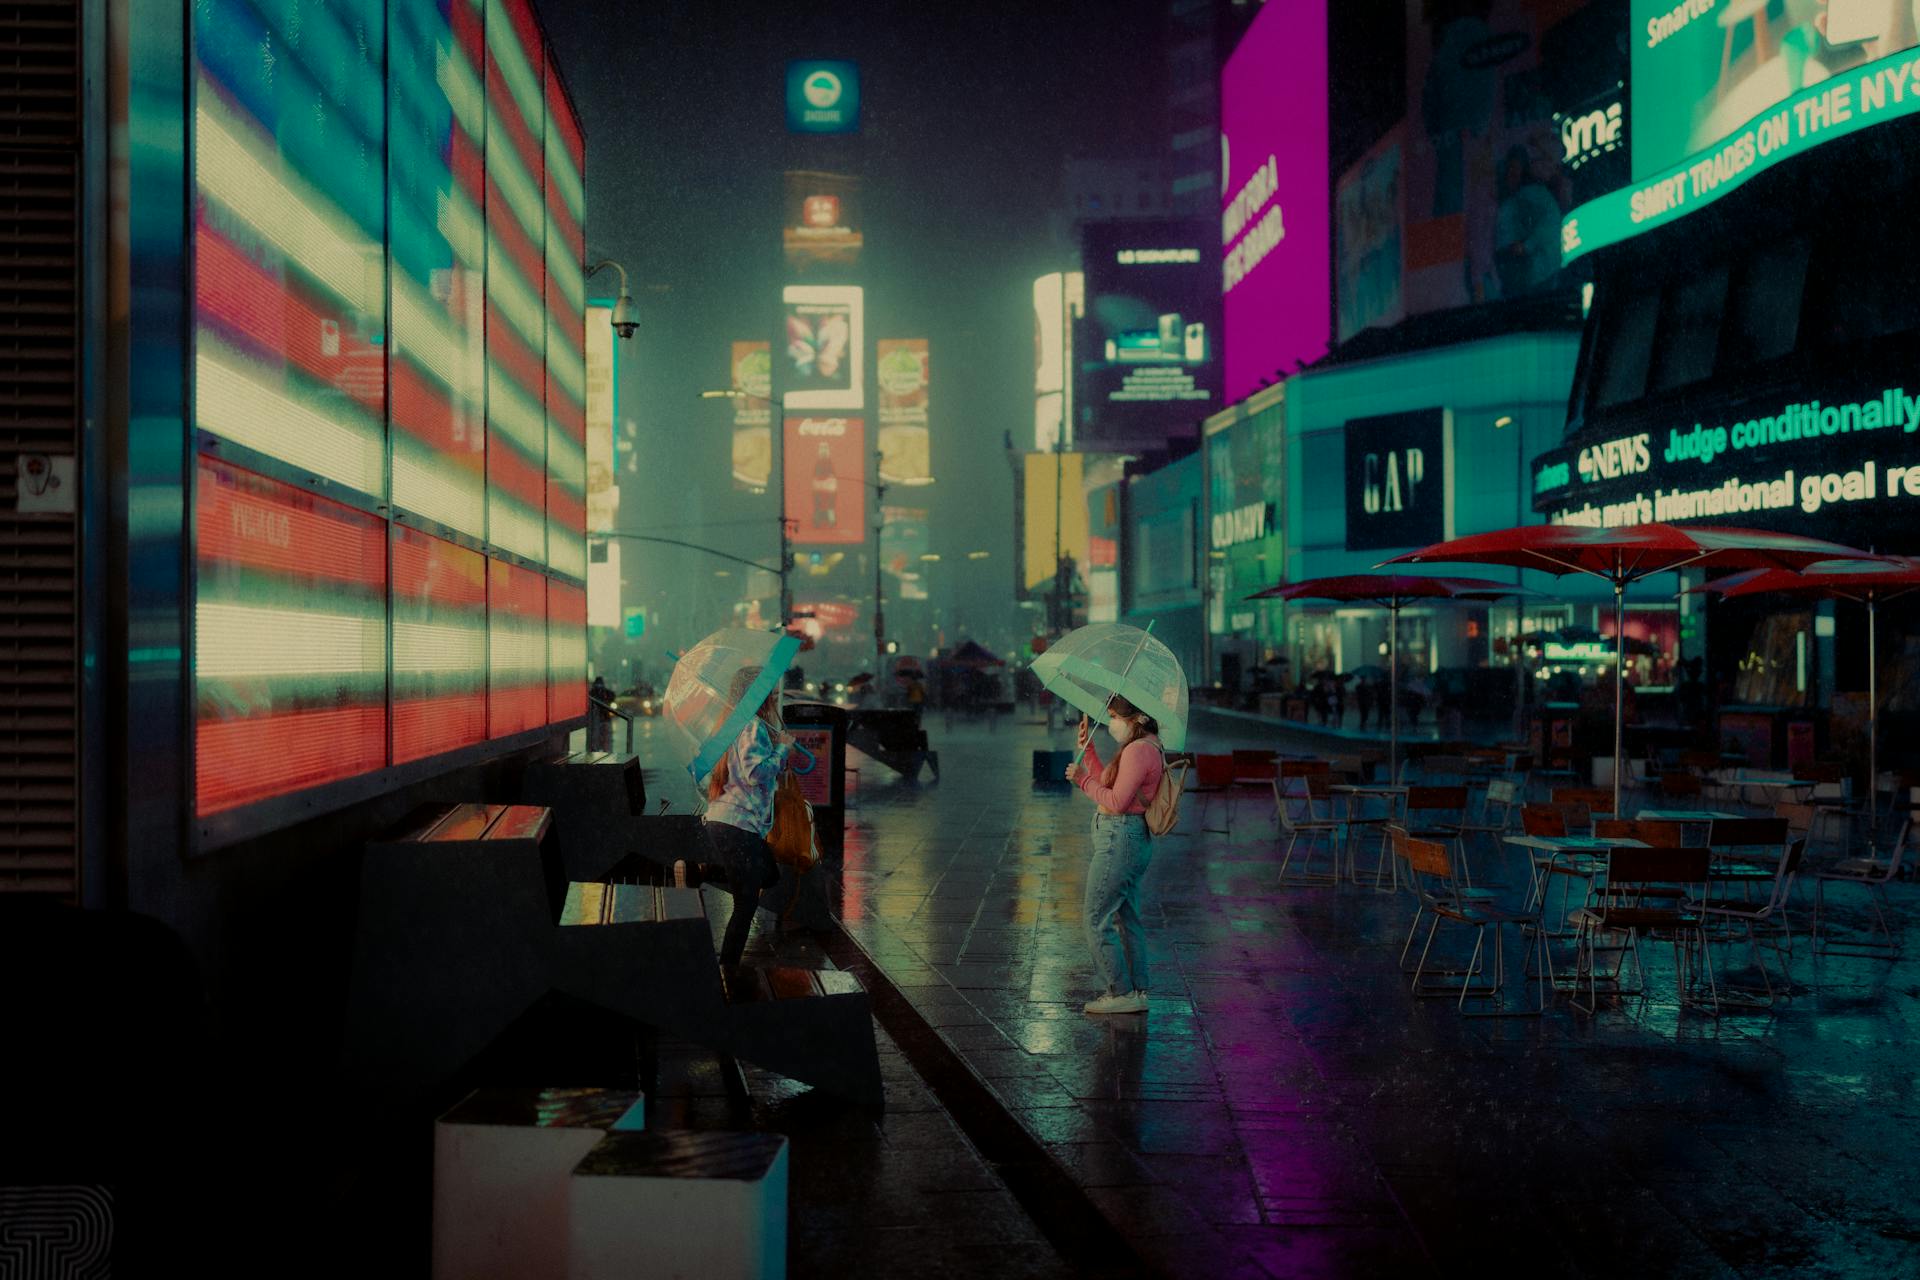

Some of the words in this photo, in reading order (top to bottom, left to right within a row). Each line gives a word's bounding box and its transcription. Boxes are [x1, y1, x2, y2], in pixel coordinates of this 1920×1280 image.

[1630, 172, 1686, 223] SMRT
[1689, 131, 1755, 198] TRADES
[1757, 110, 1789, 156] ON
[1793, 83, 1852, 137] THE
[1664, 424, 1727, 464] Judge
[1731, 388, 1920, 450] conditionally
[1363, 448, 1424, 514] GAP
[1602, 492, 1653, 528] men's
[1655, 471, 1794, 523] international
[1800, 461, 1876, 513] goal
